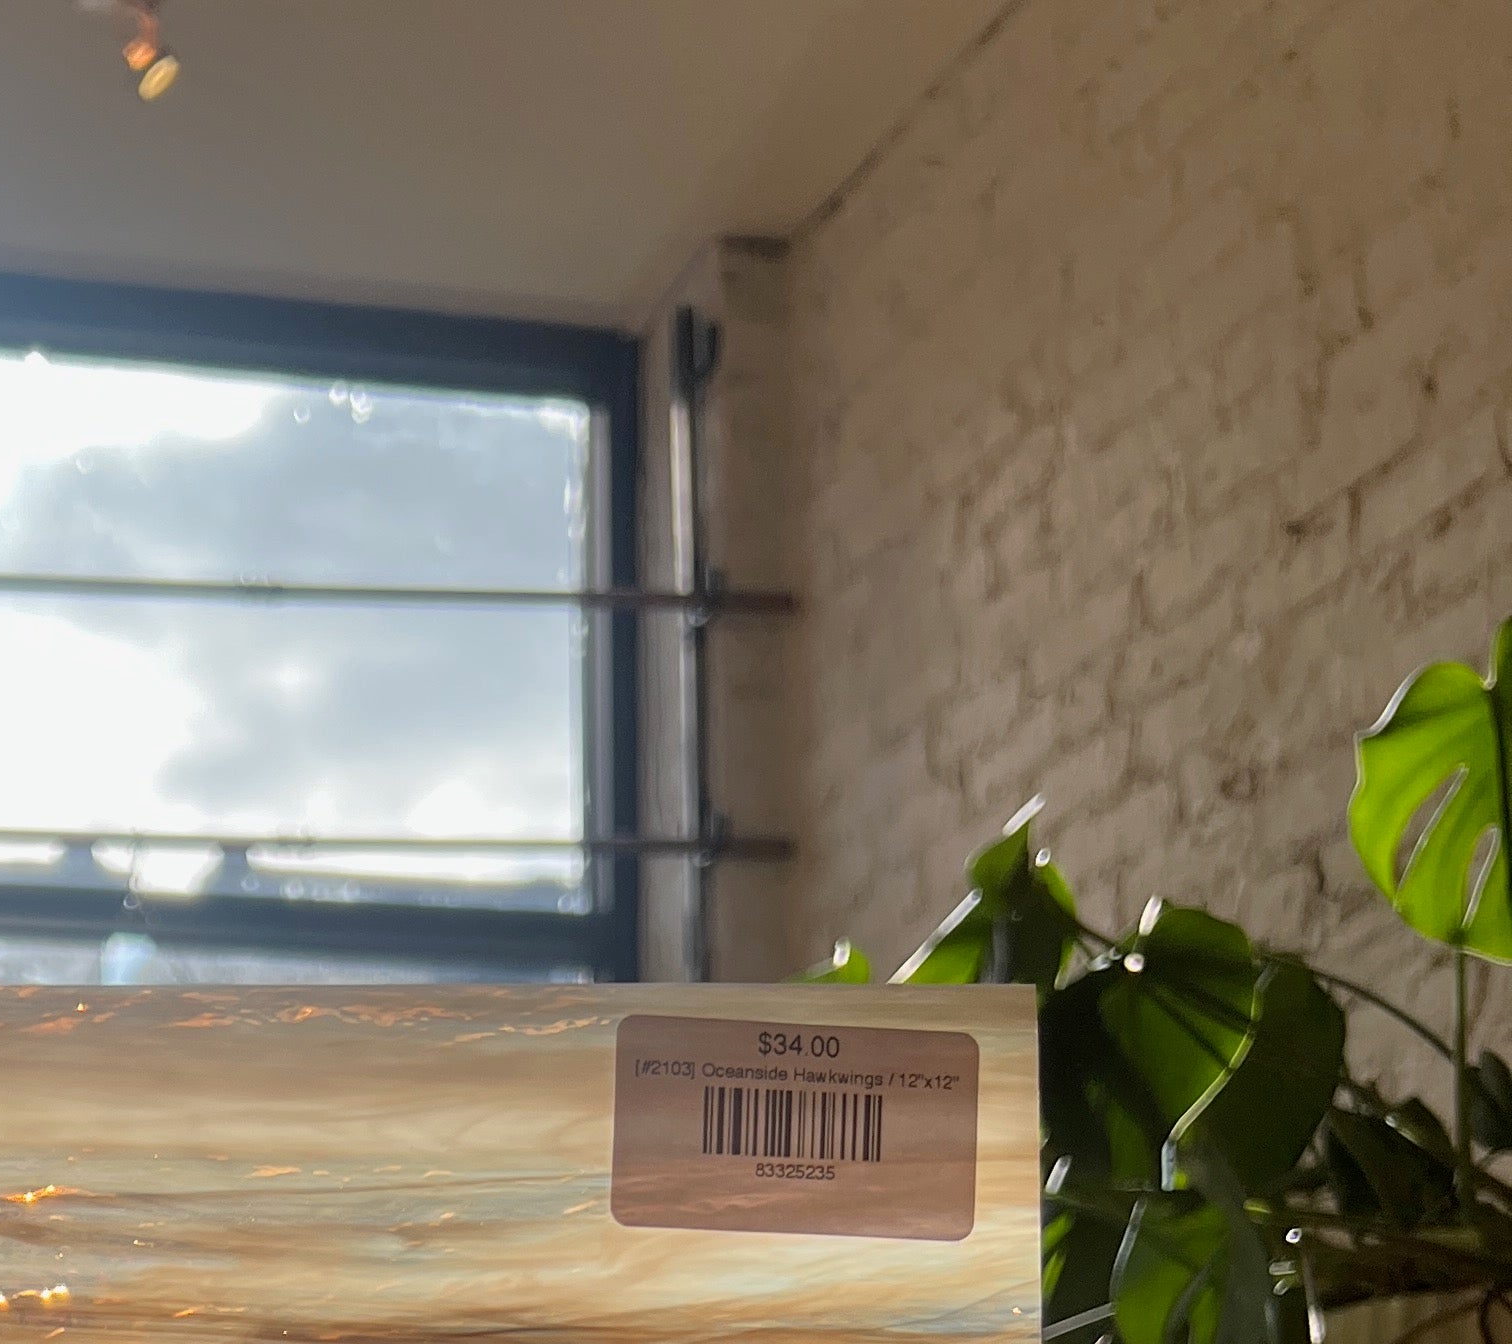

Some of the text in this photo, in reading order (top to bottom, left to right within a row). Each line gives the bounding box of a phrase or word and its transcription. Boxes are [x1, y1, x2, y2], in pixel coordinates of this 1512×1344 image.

[758, 1031, 840, 1058] $34.00
[635, 1059, 695, 1080] [#2103]
[702, 1062, 788, 1081] Oceanside
[793, 1067, 883, 1089] Hawkwings
[900, 1073, 960, 1090] 12"x12"
[755, 1162, 836, 1180] 83325235
